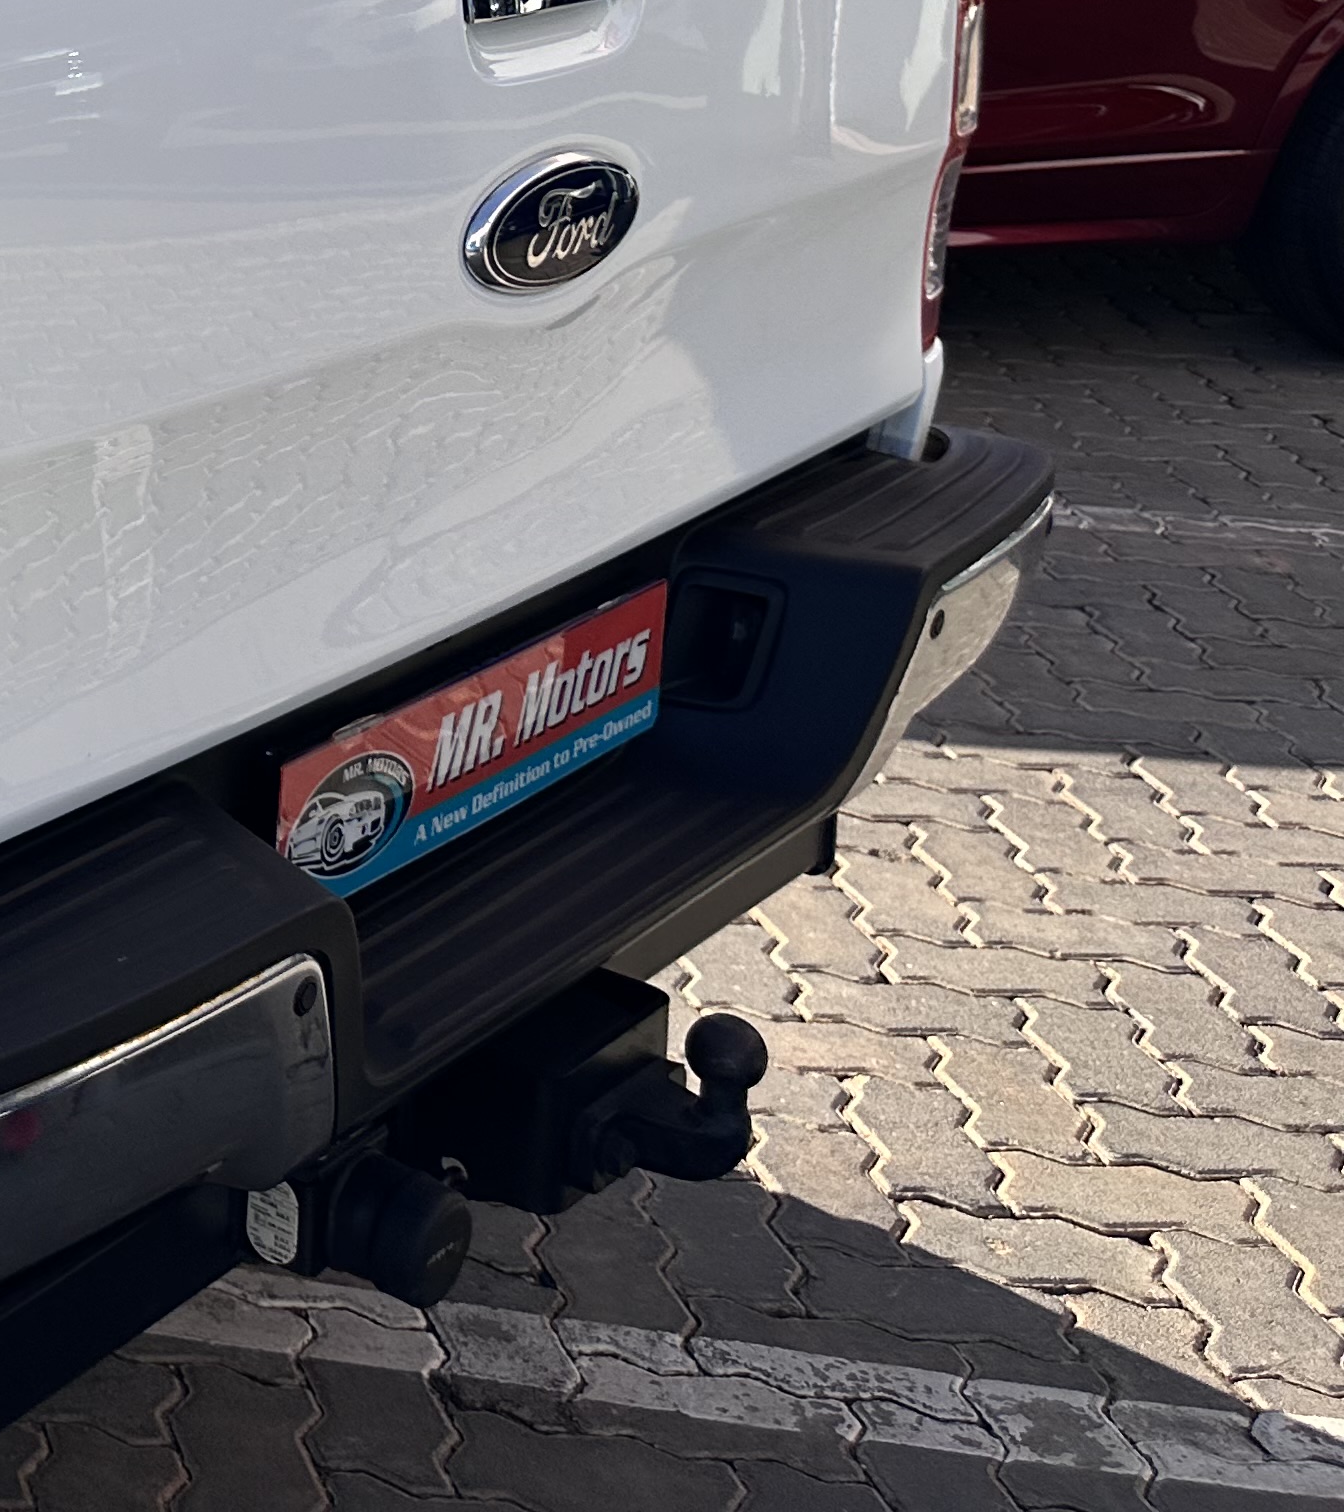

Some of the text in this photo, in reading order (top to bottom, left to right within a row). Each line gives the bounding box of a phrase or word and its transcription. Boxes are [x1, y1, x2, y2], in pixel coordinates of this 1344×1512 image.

[526, 180, 618, 268] Ford
[413, 699, 654, 847] A New Definition to Pre-Owned
[425, 628, 652, 794] MR. Motors
